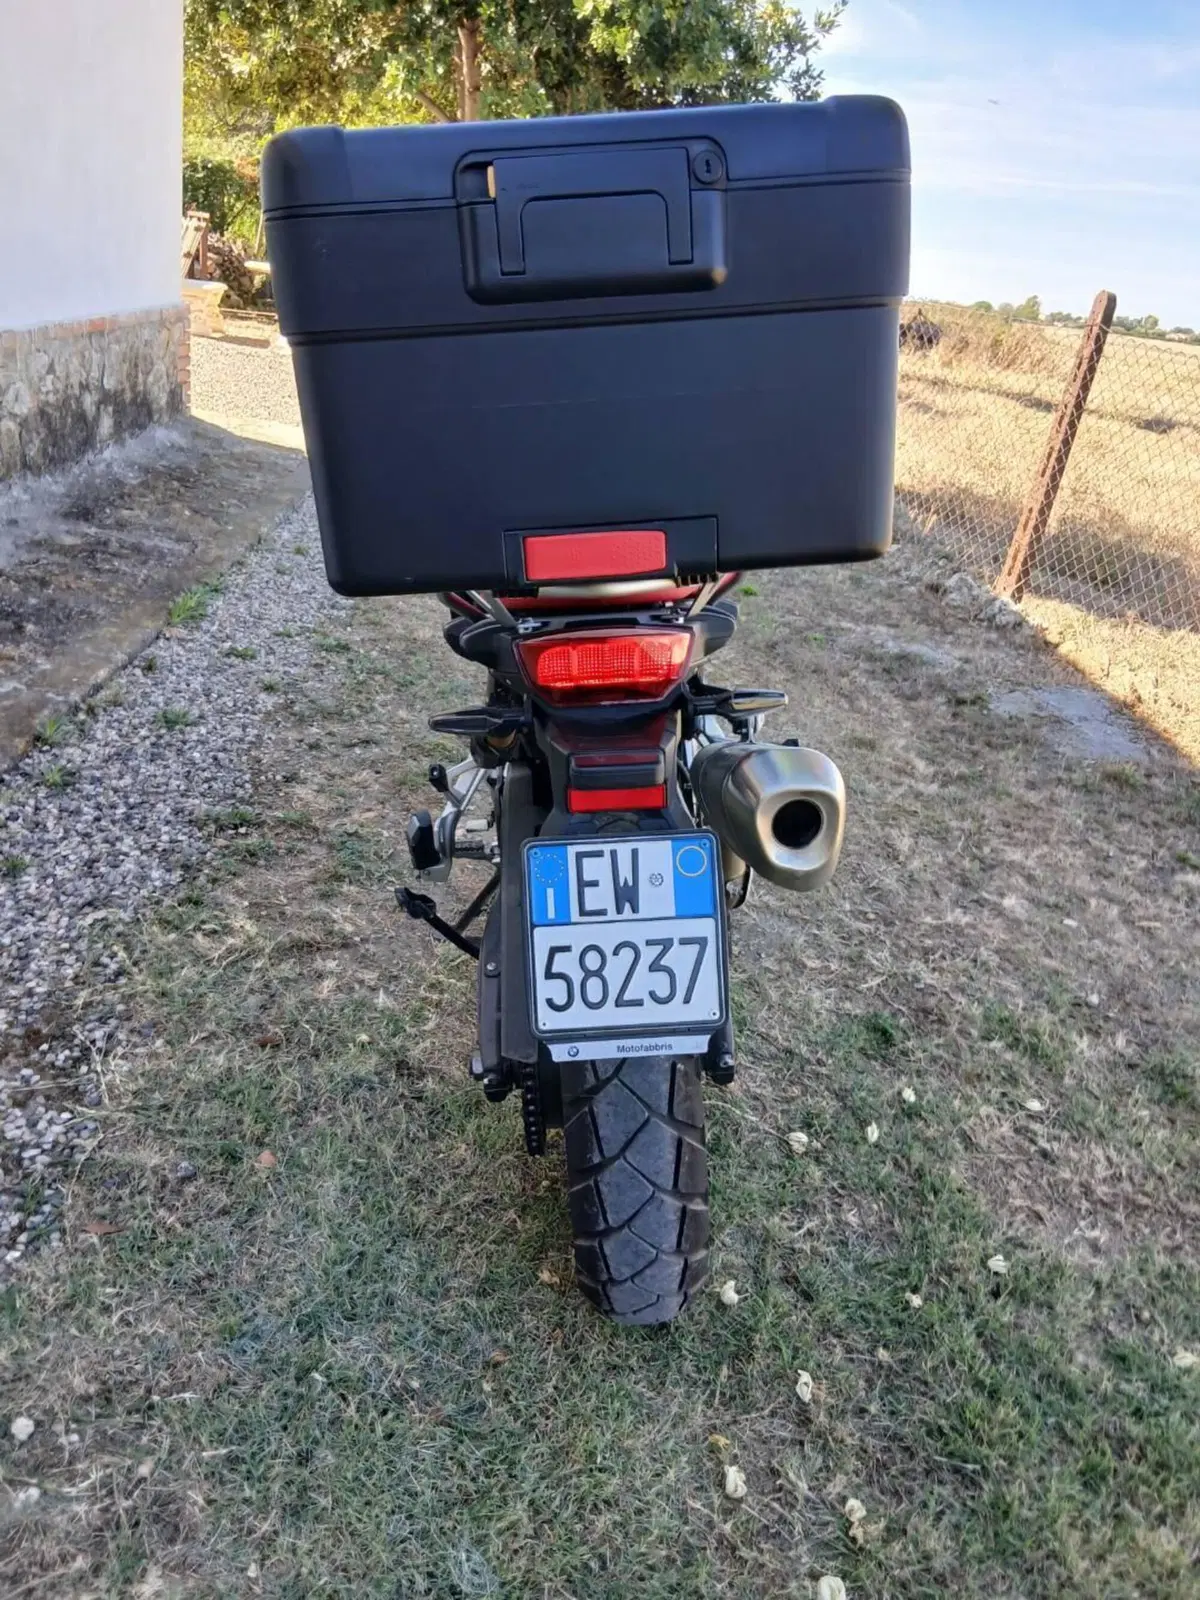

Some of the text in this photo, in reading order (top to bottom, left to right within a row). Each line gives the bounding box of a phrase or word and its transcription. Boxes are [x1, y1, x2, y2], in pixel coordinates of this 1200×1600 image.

[546, 887, 555, 919] I
[575, 848, 640, 917] EW
[544, 936, 709, 1012] 58237
[616, 1042, 673, 1054] Motofabbris
